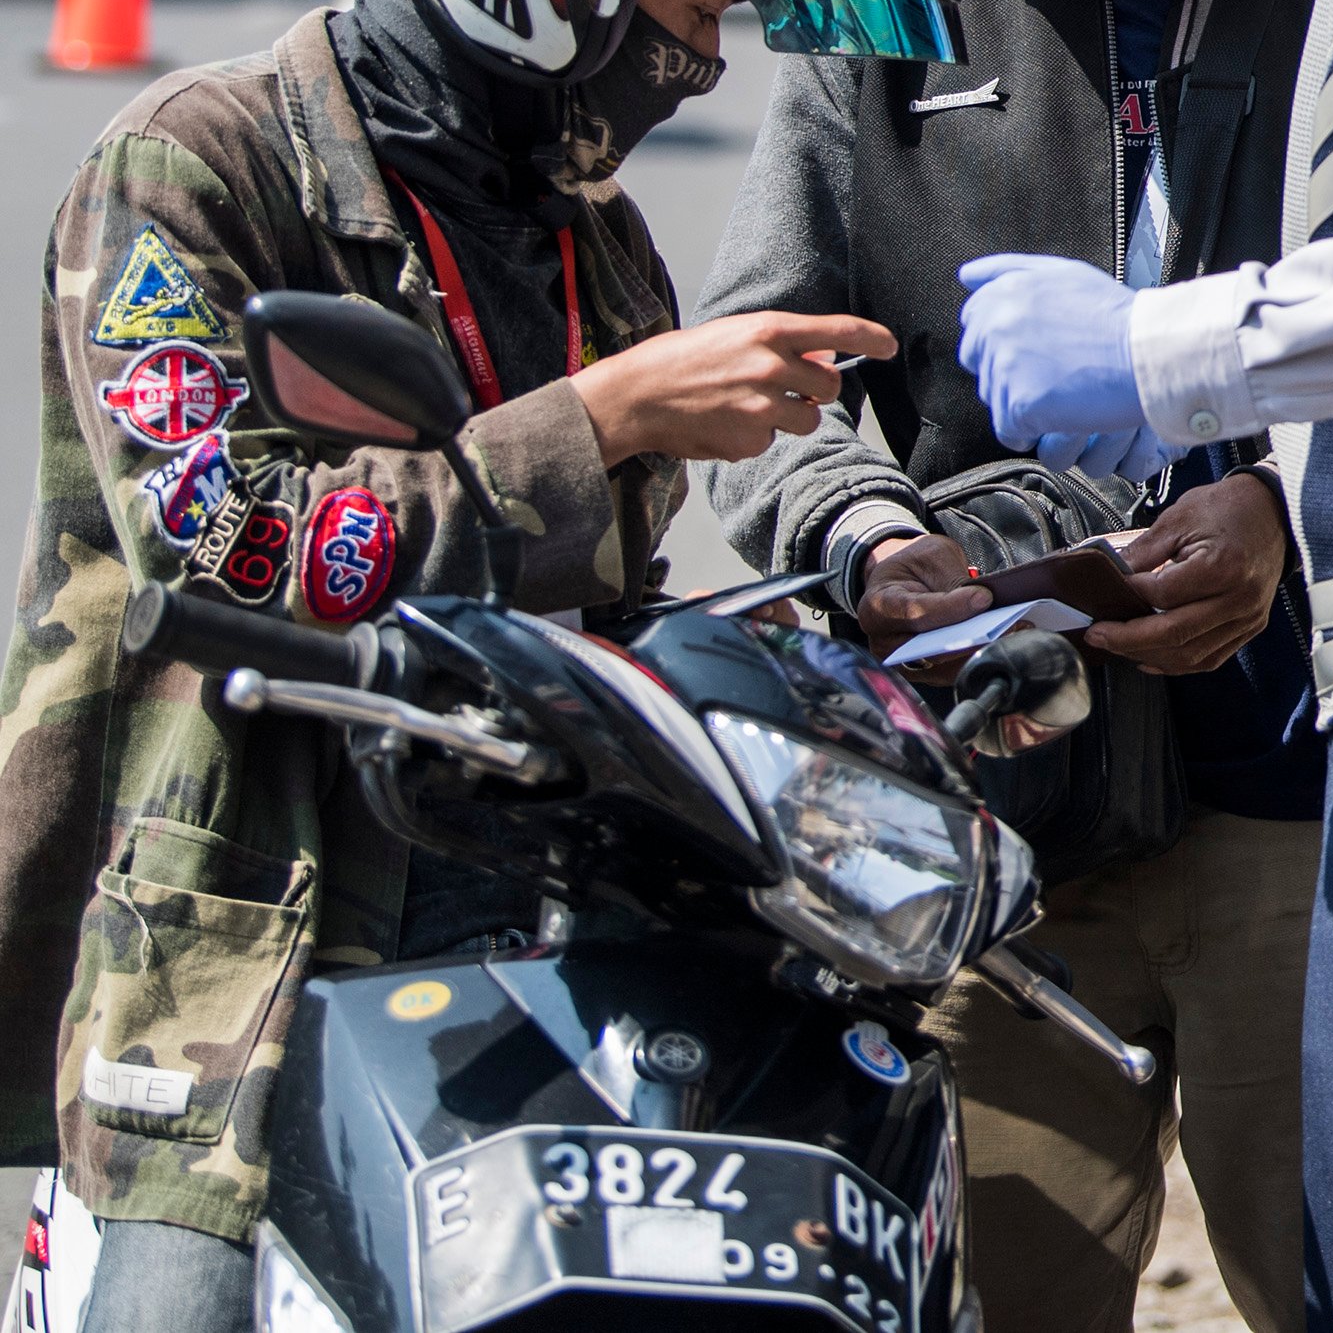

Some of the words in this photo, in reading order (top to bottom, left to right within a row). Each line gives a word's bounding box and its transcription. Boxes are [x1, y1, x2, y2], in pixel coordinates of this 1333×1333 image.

[134, 390, 216, 404] LONDON
[194, 492, 247, 572] ROUTE
[228, 514, 288, 587] 69
[425, 1166, 470, 1246] E
[542, 1141, 748, 1210] 3824
[834, 1172, 905, 1282] BK
